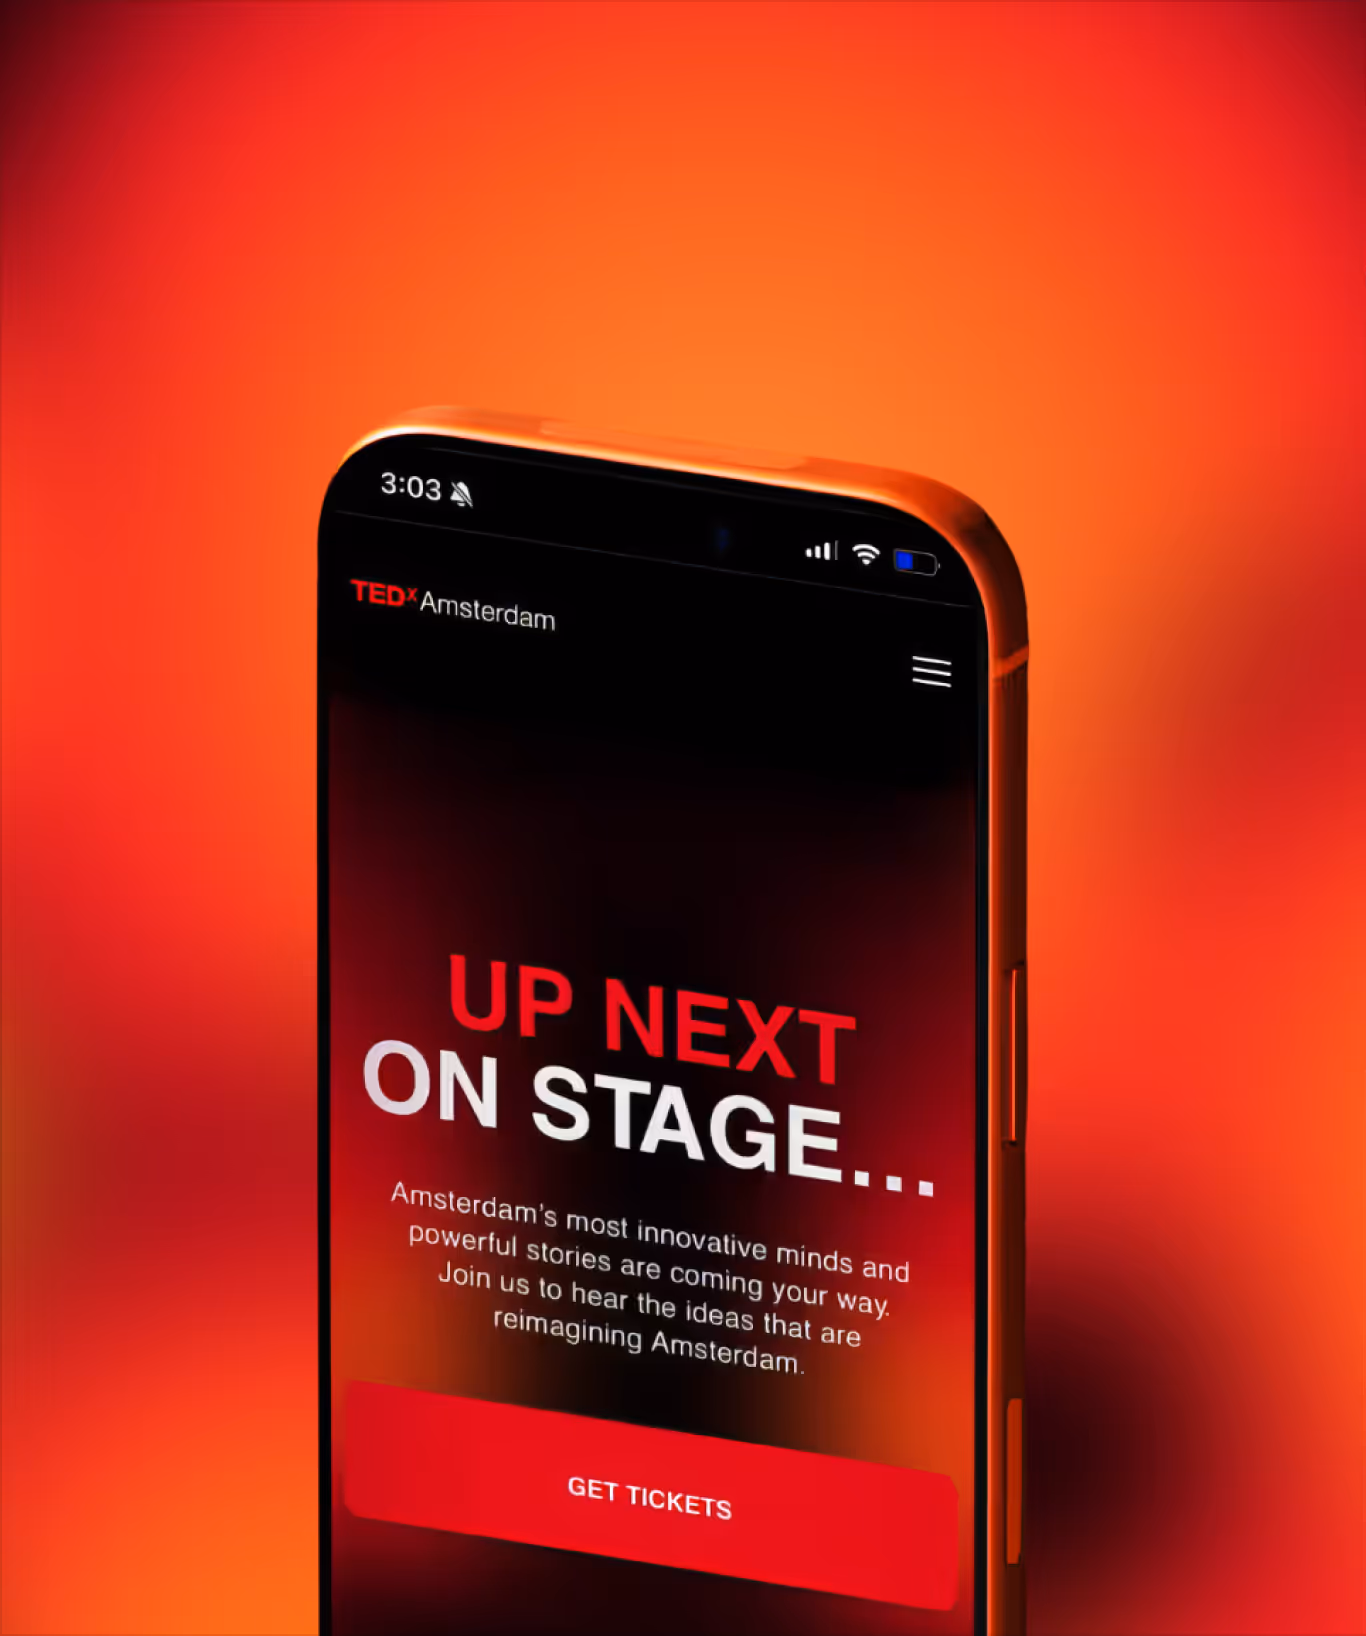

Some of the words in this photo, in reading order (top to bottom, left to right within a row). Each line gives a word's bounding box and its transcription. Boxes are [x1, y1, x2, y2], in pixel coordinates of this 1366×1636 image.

[380, 471, 442, 502] 3:03
[449, 953, 574, 1039] UP
[605, 977, 857, 1086] NEXT
[363, 1038, 499, 1129] ON
[531, 1065, 936, 1199] STAGE...
[391, 1180, 558, 1228] Amsterdam's
[566, 1211, 630, 1241] most
[637, 1219, 768, 1261] innovative
[776, 1240, 855, 1277] minds
[862, 1259, 911, 1285] and
[408, 1222, 518, 1258] powerful
[526, 1239, 612, 1272] stories
[620, 1256, 662, 1280] are
[669, 1264, 764, 1301] coming
[771, 1283, 829, 1308] your
[836, 1292, 891, 1322] way.
[438, 1261, 491, 1290] Join
[500, 1271, 531, 1295] us
[539, 1276, 564, 1301] to
[571, 1282, 630, 1312] hear
[637, 1289, 678, 1319] the
[685, 1298, 756, 1331] ideas
[763, 1311, 813, 1342] that
[820, 1325, 863, 1349] are
[493, 1306, 643, 1355] reimagining
[651, 1330, 807, 1376] Amsterdam.
[567, 1476, 620, 1503] GET
[626, 1484, 734, 1521] TICKETS
